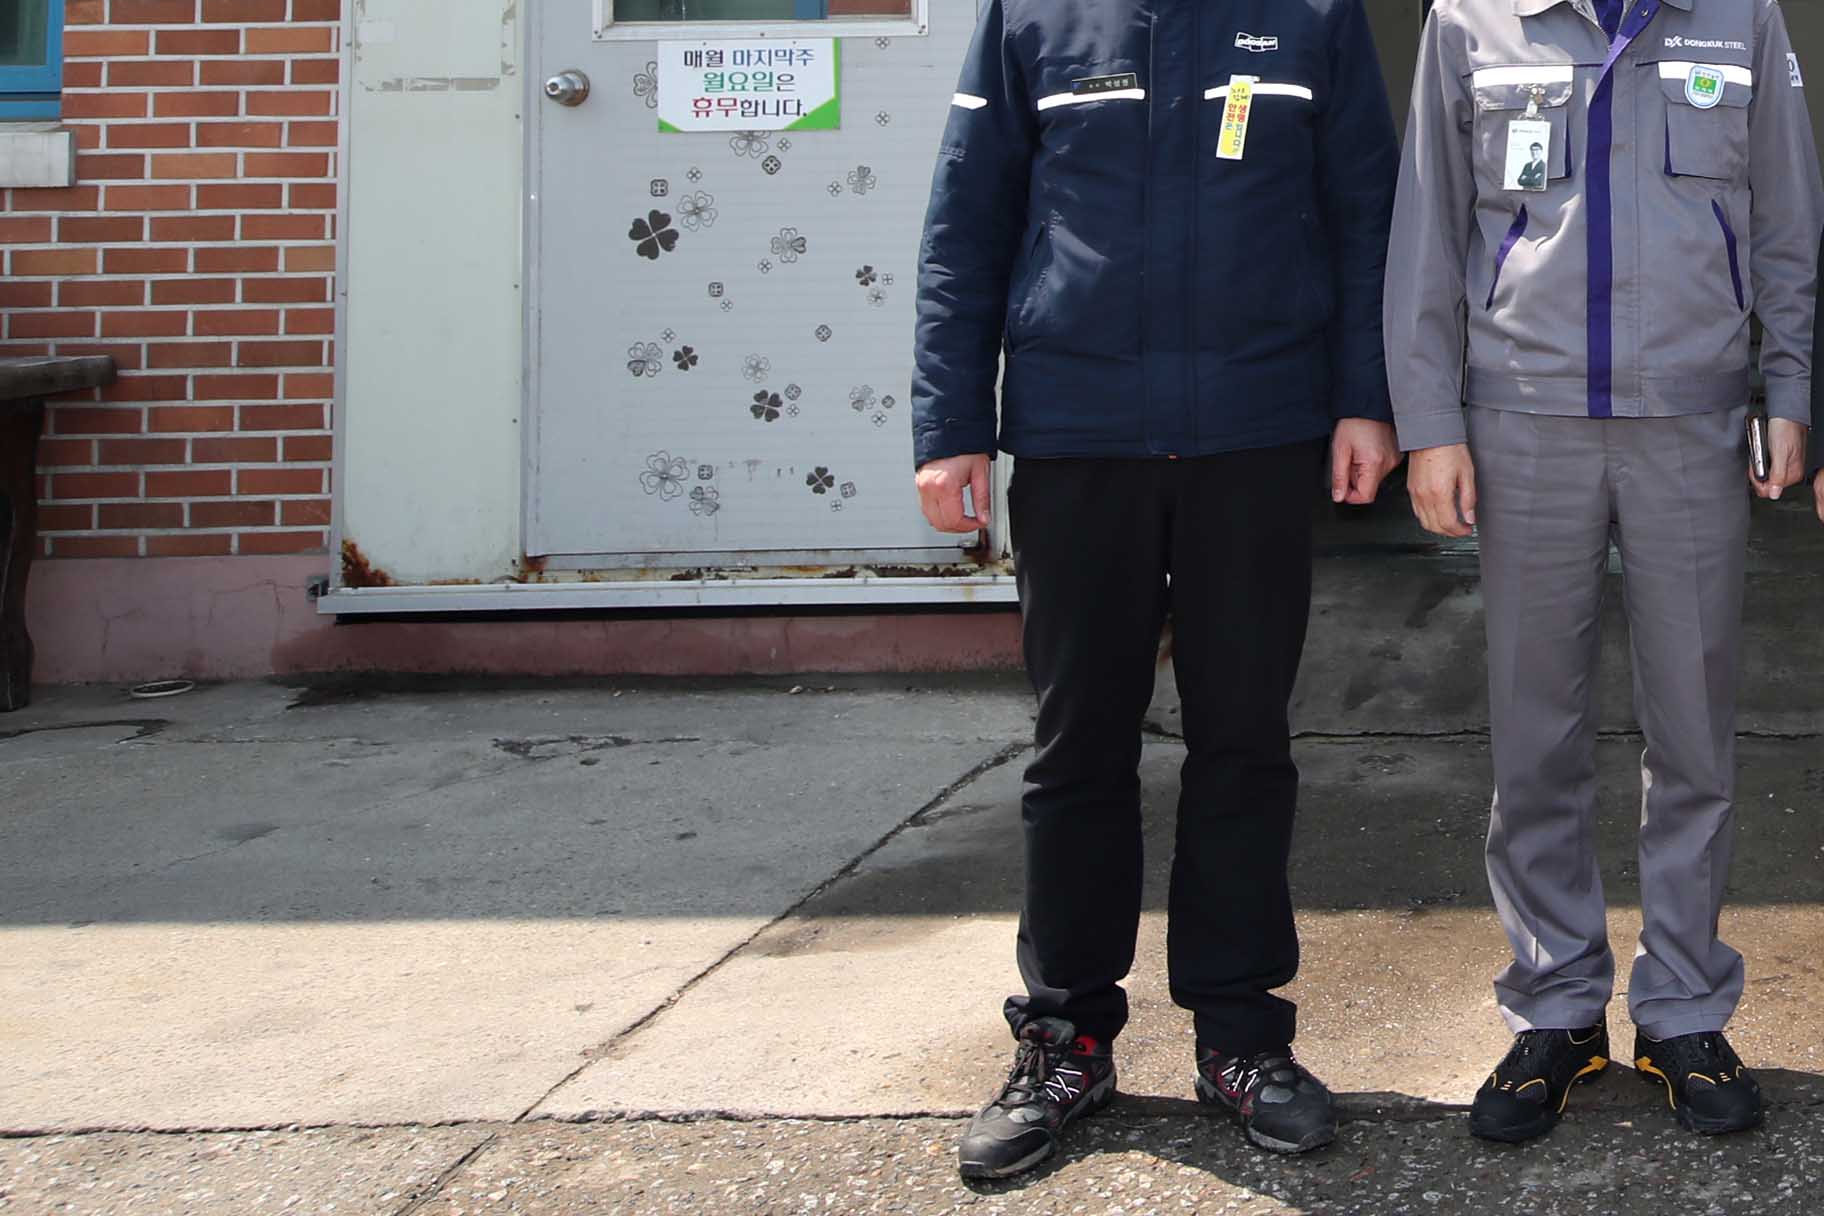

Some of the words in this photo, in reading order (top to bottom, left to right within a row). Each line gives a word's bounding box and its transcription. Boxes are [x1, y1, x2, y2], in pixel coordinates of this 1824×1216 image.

[1684, 39, 1723, 49] DONGKUK
[1724, 41, 1746, 50] STEEL
[683, 49, 724, 68] 매월
[732, 48, 816, 67] 마지막주
[703, 72, 795, 93] 월요일은
[692, 97, 807, 118] 휴무합니다.
